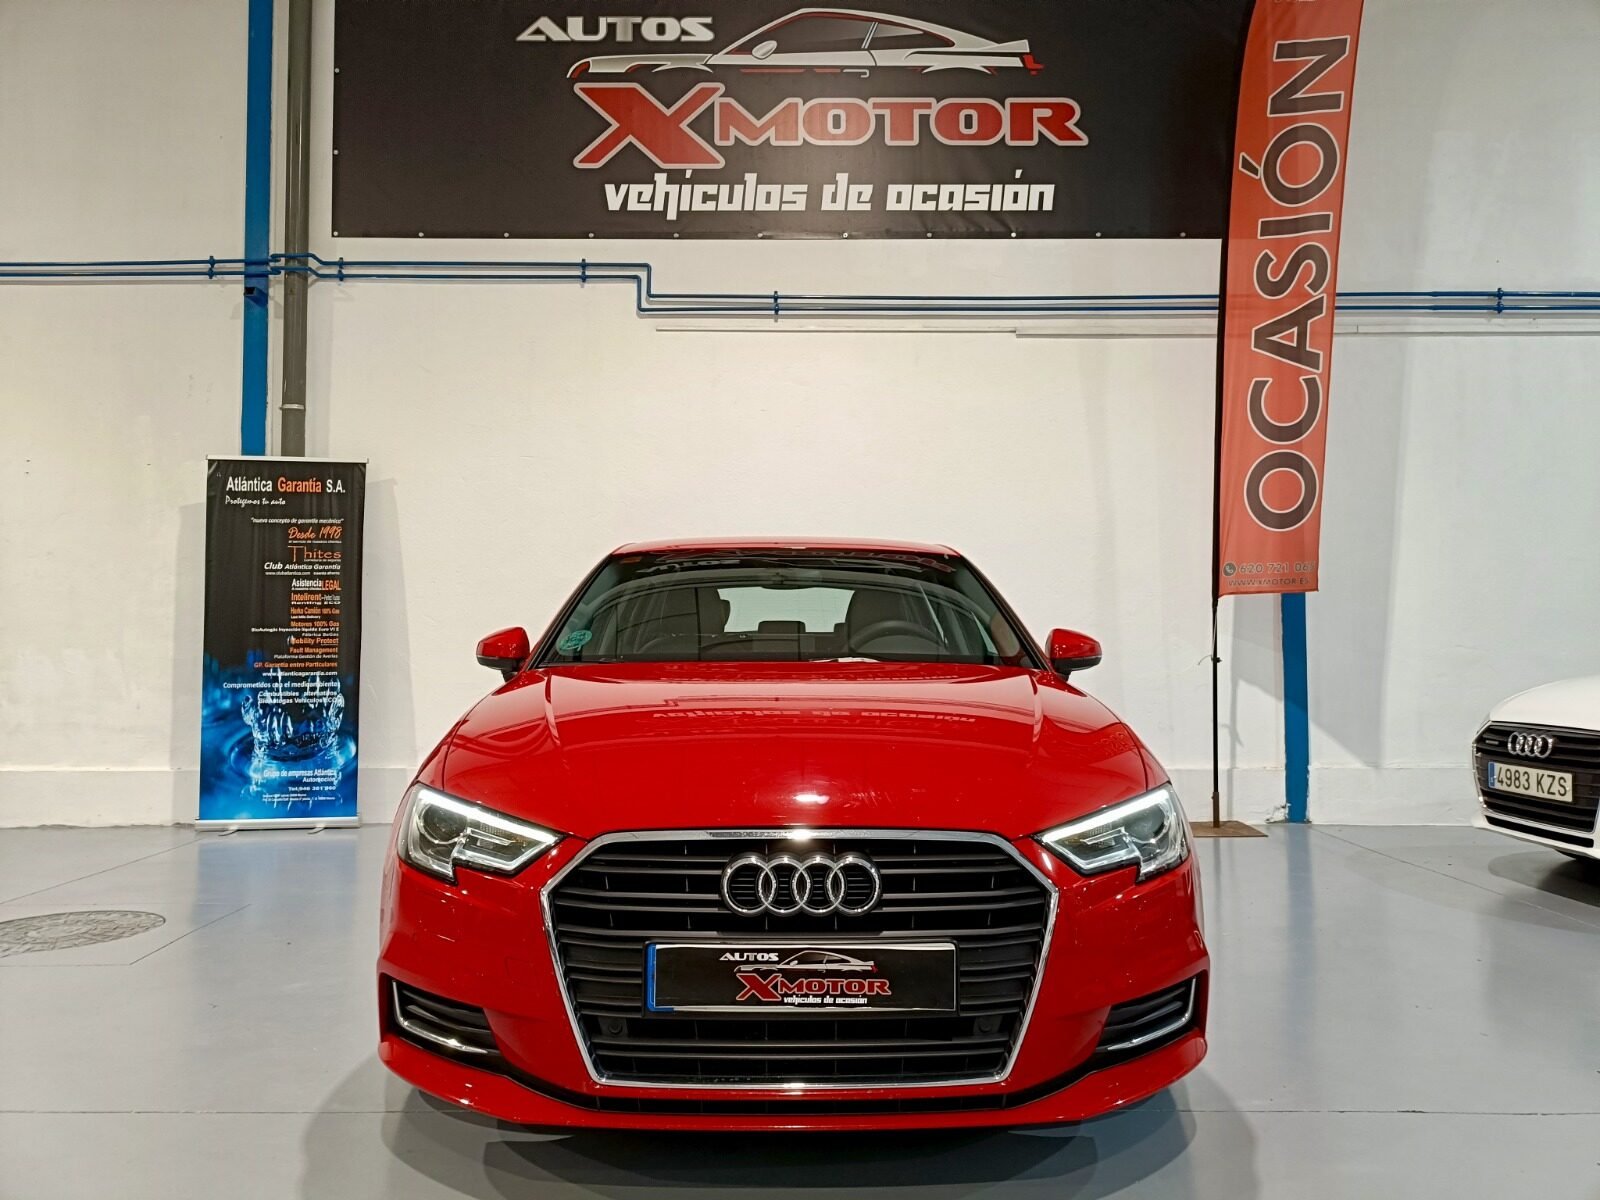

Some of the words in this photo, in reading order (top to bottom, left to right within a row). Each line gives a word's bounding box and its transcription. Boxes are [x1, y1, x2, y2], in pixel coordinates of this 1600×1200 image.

[515, 16, 715, 43] AUTOS
[572, 81, 1089, 170] XMOTOR
[604, 169, 809, 221] vehículos
[821, 172, 876, 213] de
[886, 169, 1055, 213] ocasión
[1239, 35, 1350, 532] OCASIÓN
[226, 476, 273, 492] Atlántica
[277, 477, 322, 493] Garantía
[326, 479, 346, 493] S.A.
[288, 526, 316, 539] Desde
[319, 525, 343, 539] 1998
[288, 545, 341, 562] Thites
[264, 562, 283, 570] Club
[223, 681, 271, 689] Comprometidos
[280, 769, 287, 777] de
[1497, 766, 1531, 791] 4983
[1536, 772, 1568, 797] KZS
[719, 952, 780, 961] AUTOS
[735, 973, 892, 1001] XMOTOR
[823, 995, 834, 1004] de
